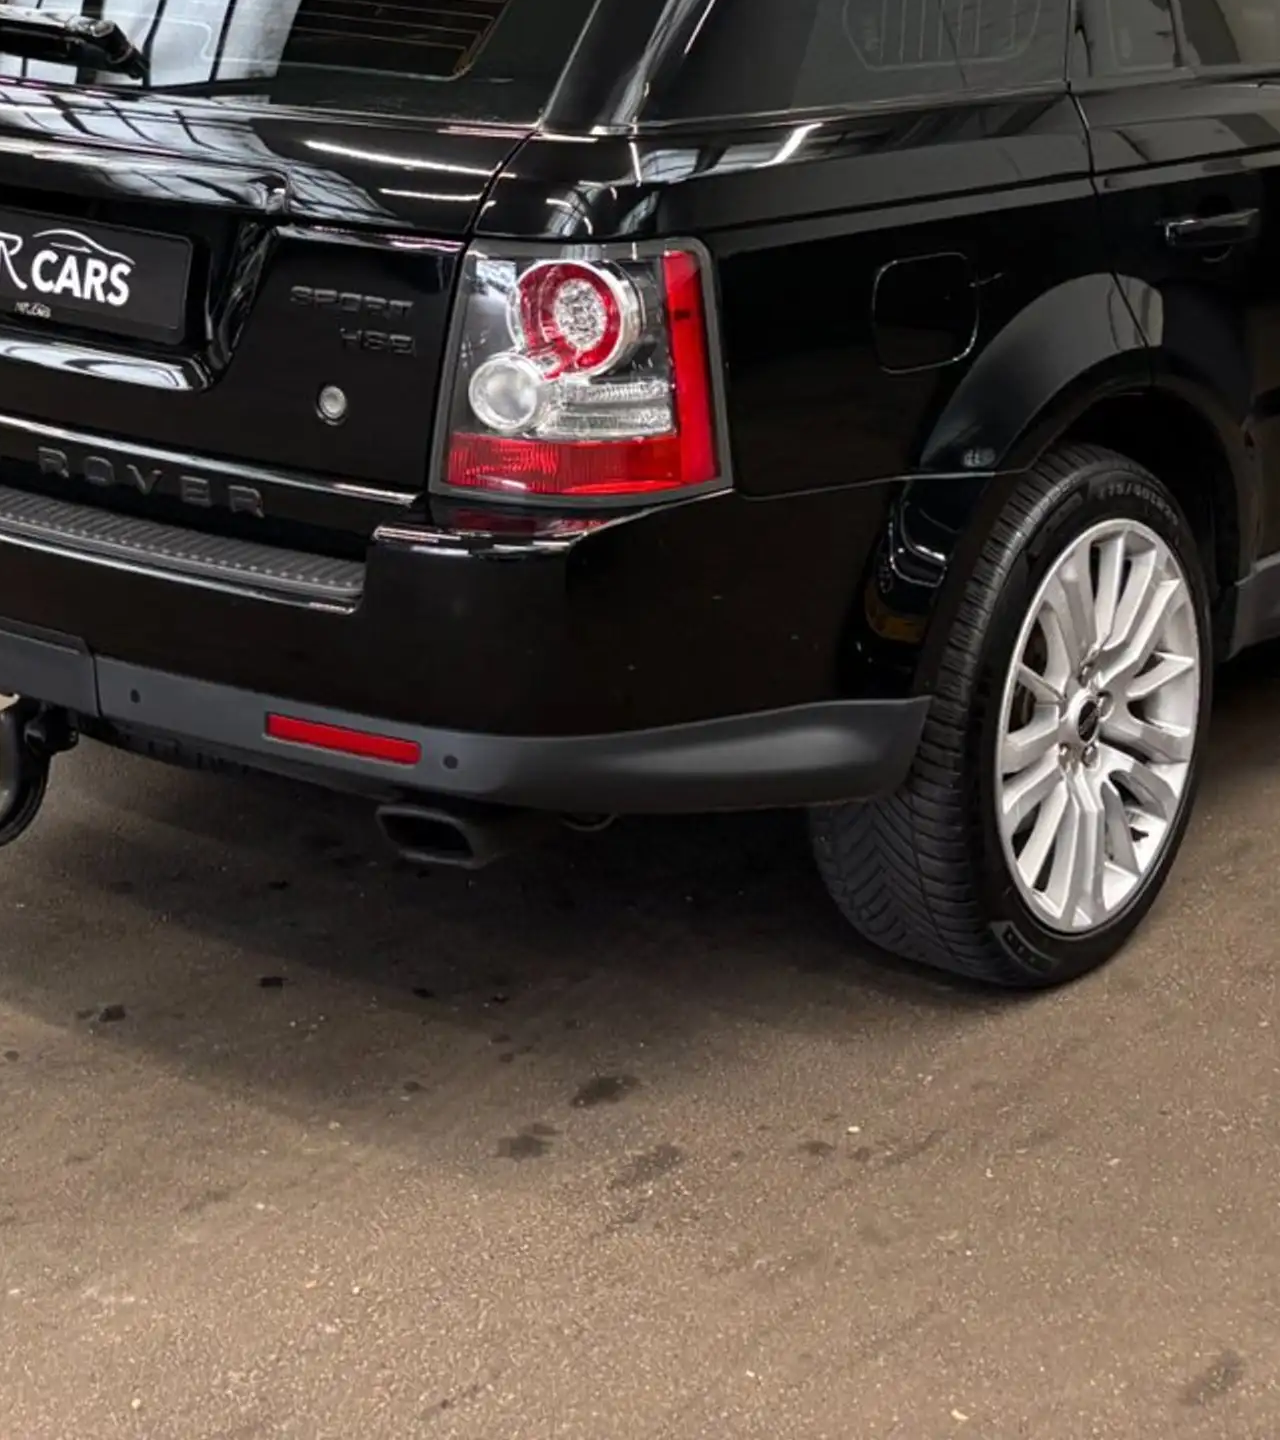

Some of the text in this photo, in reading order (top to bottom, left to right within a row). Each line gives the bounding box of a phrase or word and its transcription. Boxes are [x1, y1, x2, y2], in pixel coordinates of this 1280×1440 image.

[31, 249, 132, 307] CARS
[290, 285, 414, 319] SPORT
[38, 445, 265, 519] ROVER
